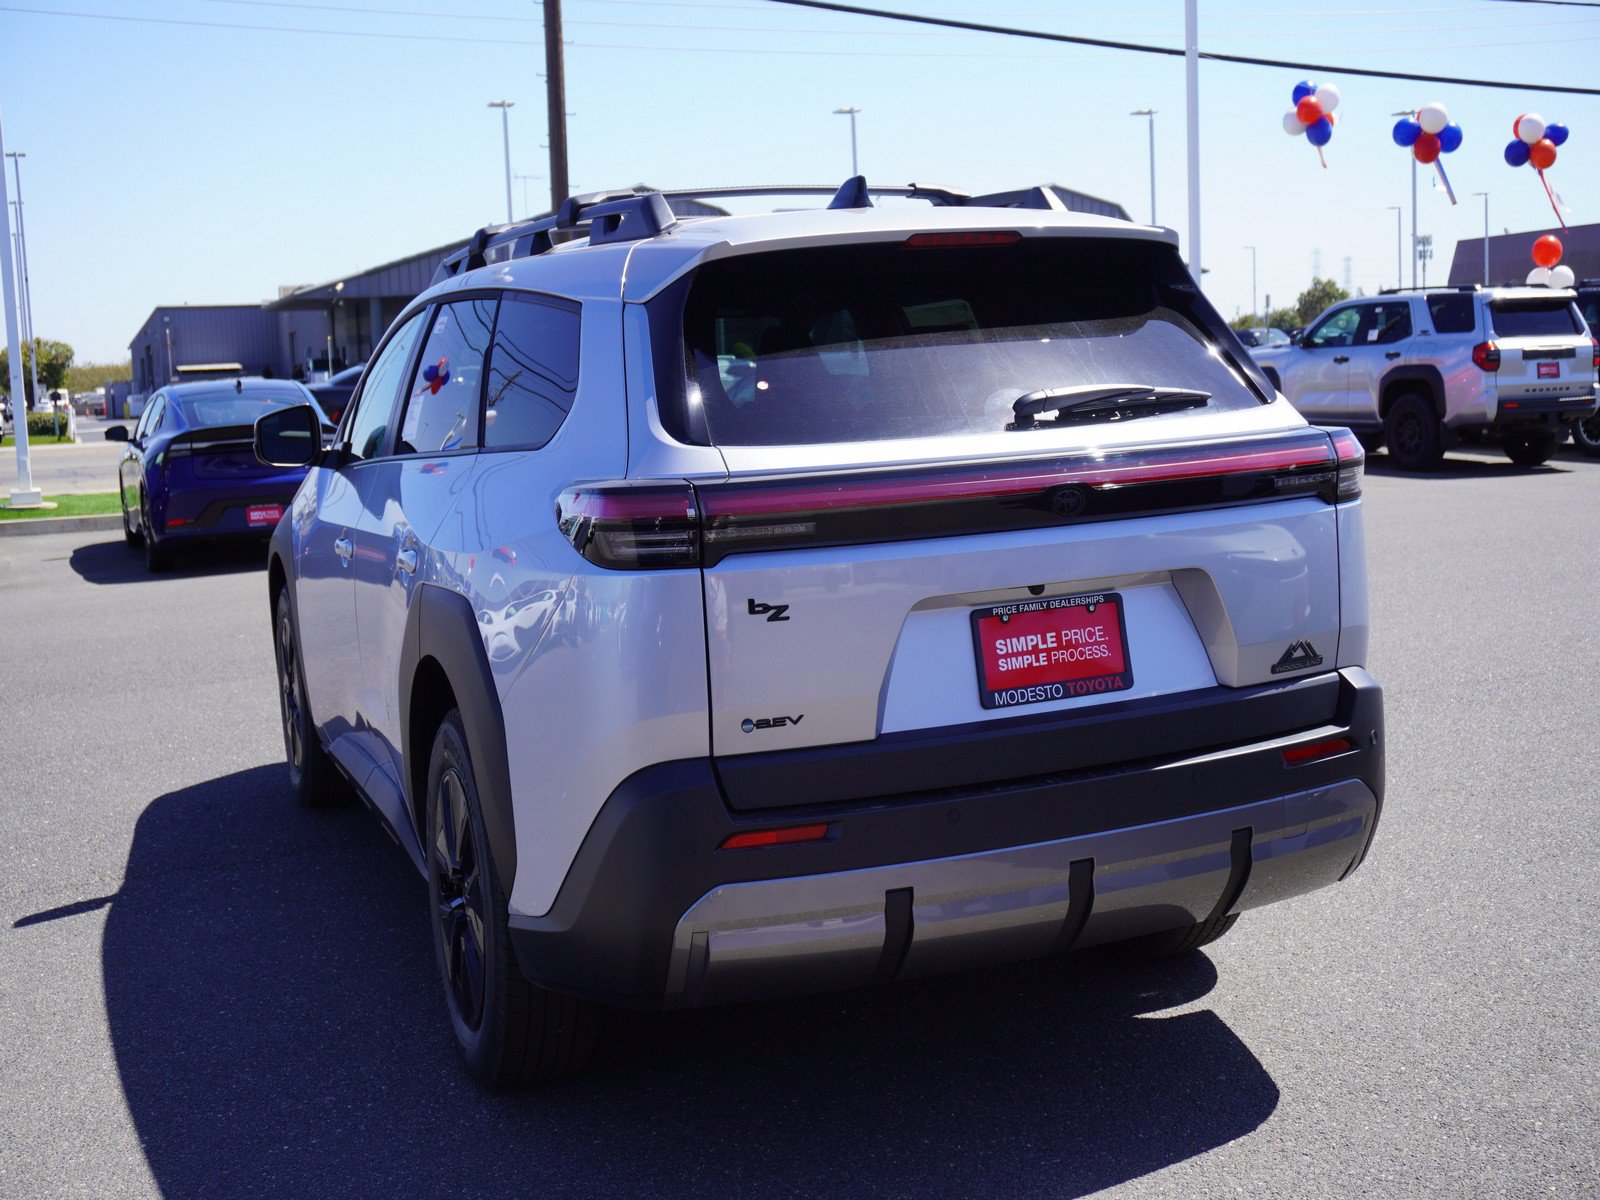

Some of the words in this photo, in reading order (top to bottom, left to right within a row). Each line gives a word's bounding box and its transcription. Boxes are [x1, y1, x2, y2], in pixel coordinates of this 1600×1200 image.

[992, 605, 1017, 616] PRICE
[1019, 602, 1047, 613] FAMILY
[1050, 595, 1104, 609] DEALERSHIPS
[995, 632, 1057, 655] SIMPLE
[1062, 626, 1109, 646] PRICE.
[998, 653, 1047, 672] SIMPLE
[1051, 645, 1112, 664] PROCESS.
[994, 684, 1063, 706] MODESTO
[1066, 676, 1124, 695] TOYOTA
